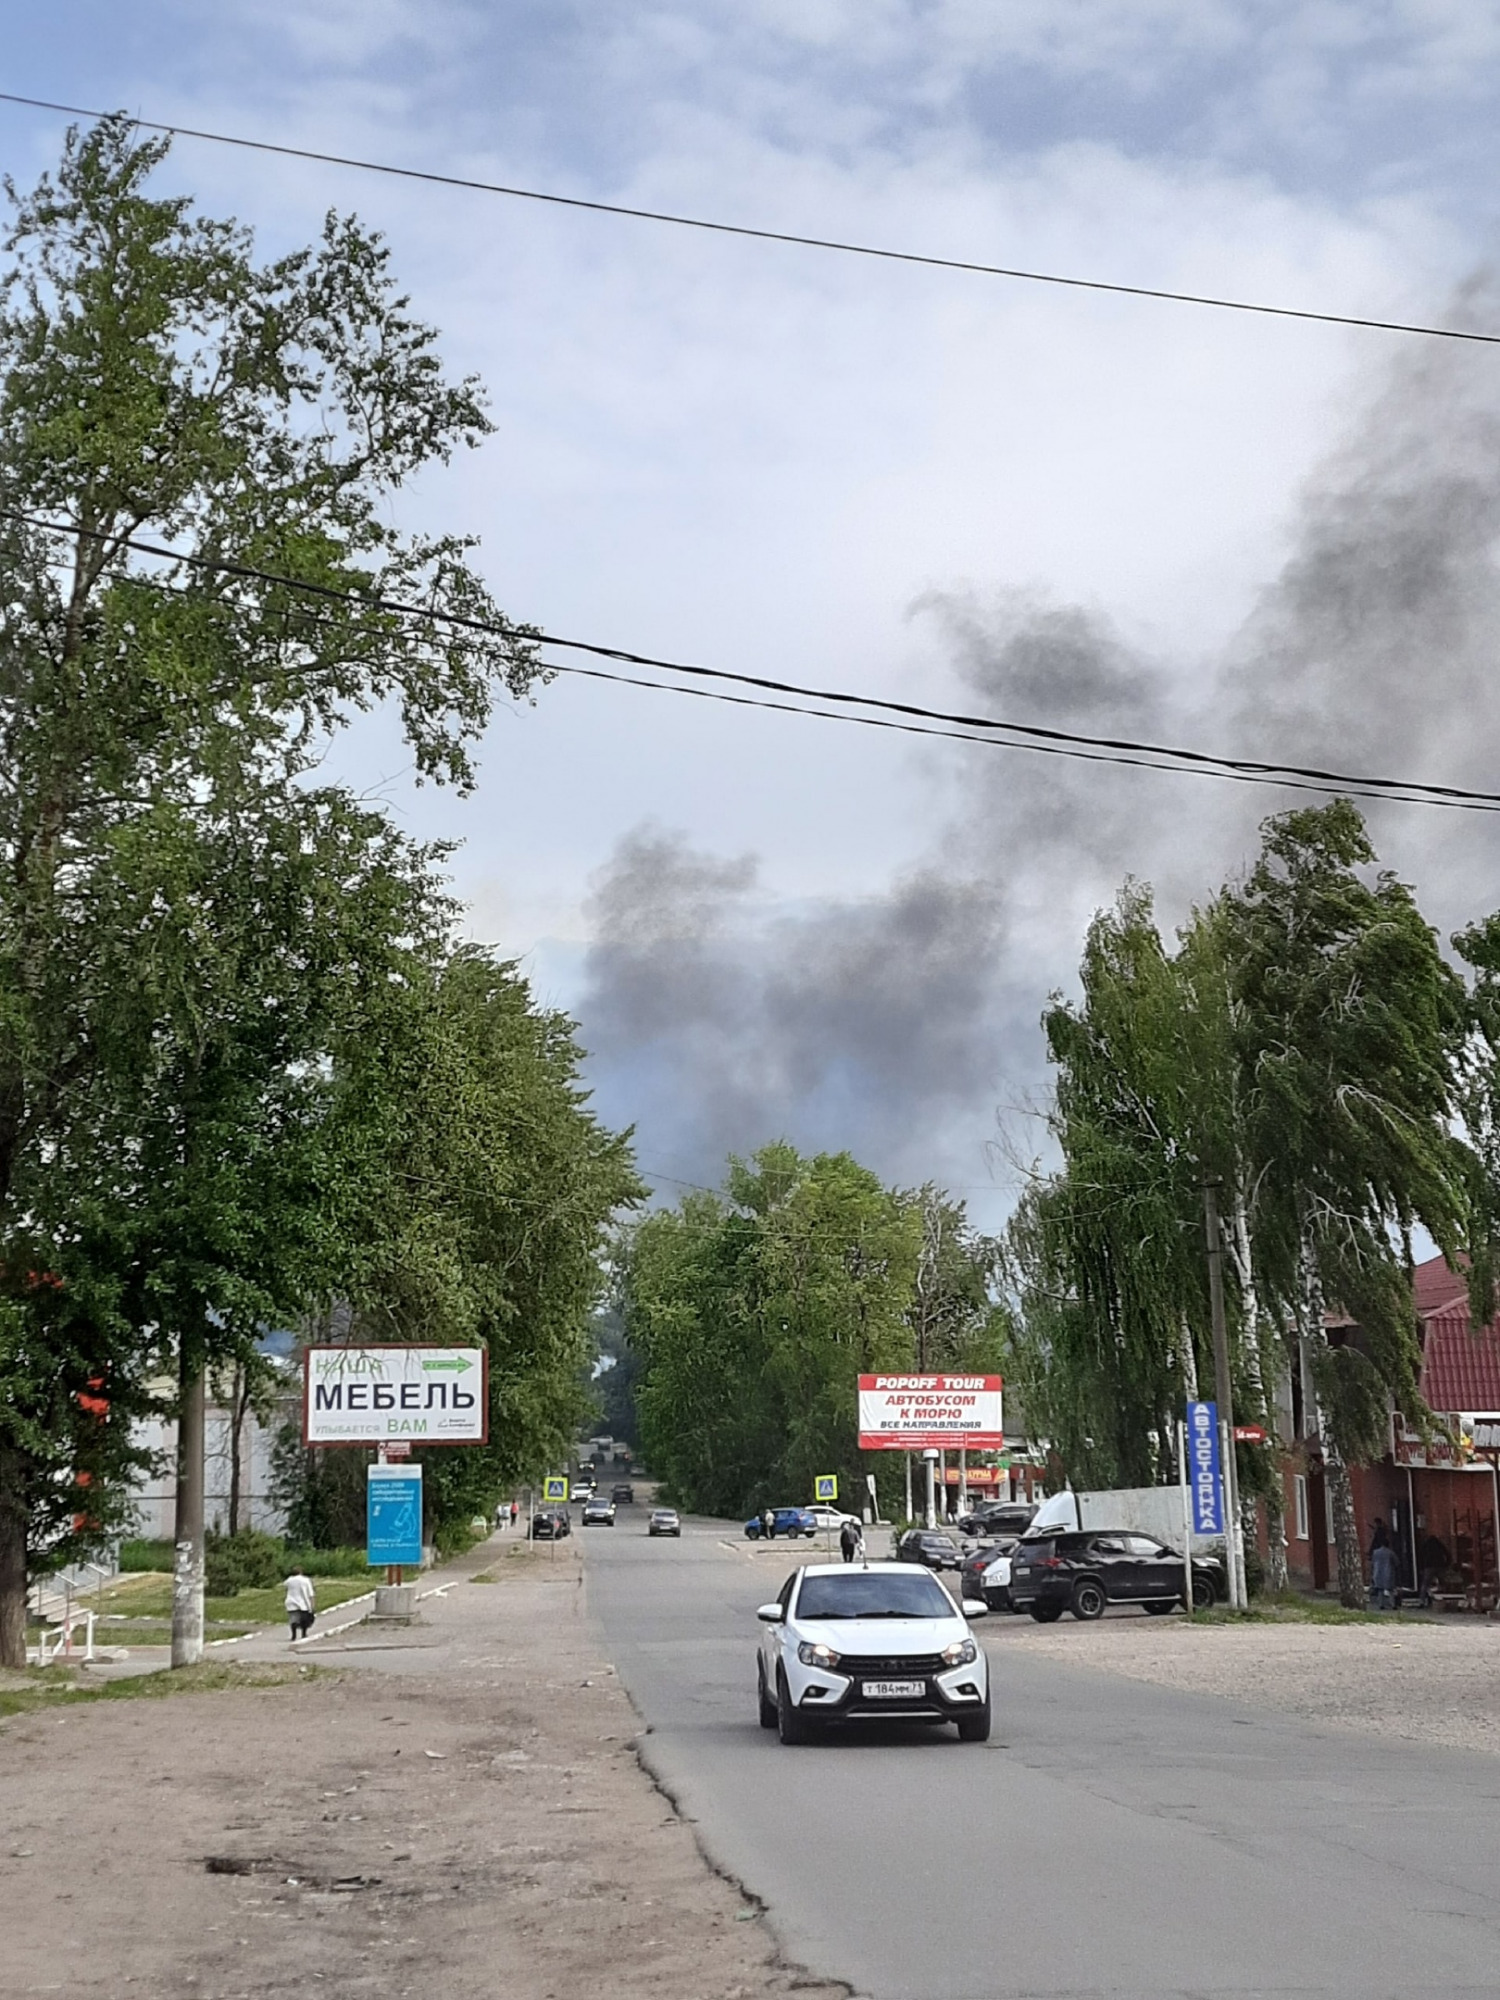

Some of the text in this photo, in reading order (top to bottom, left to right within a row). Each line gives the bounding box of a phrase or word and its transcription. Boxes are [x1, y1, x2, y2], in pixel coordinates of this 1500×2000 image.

[875, 1377, 985, 1389] POPOFF TOUR
[315, 1383, 475, 1410] МЕБЕЛЬ
[885, 1395, 976, 1406] АВТОБУСОМ
[900, 1408, 962, 1419] К МОРЮ
[314, 1424, 381, 1434] УЛЫБАЕТСЯ
[387, 1418, 428, 1433] ВАМ
[880, 1420, 982, 1429] ВСЕ НАПРАВЛЕНИЯ
[1193, 1404, 1217, 1530] АВТОСТОЯНКА
